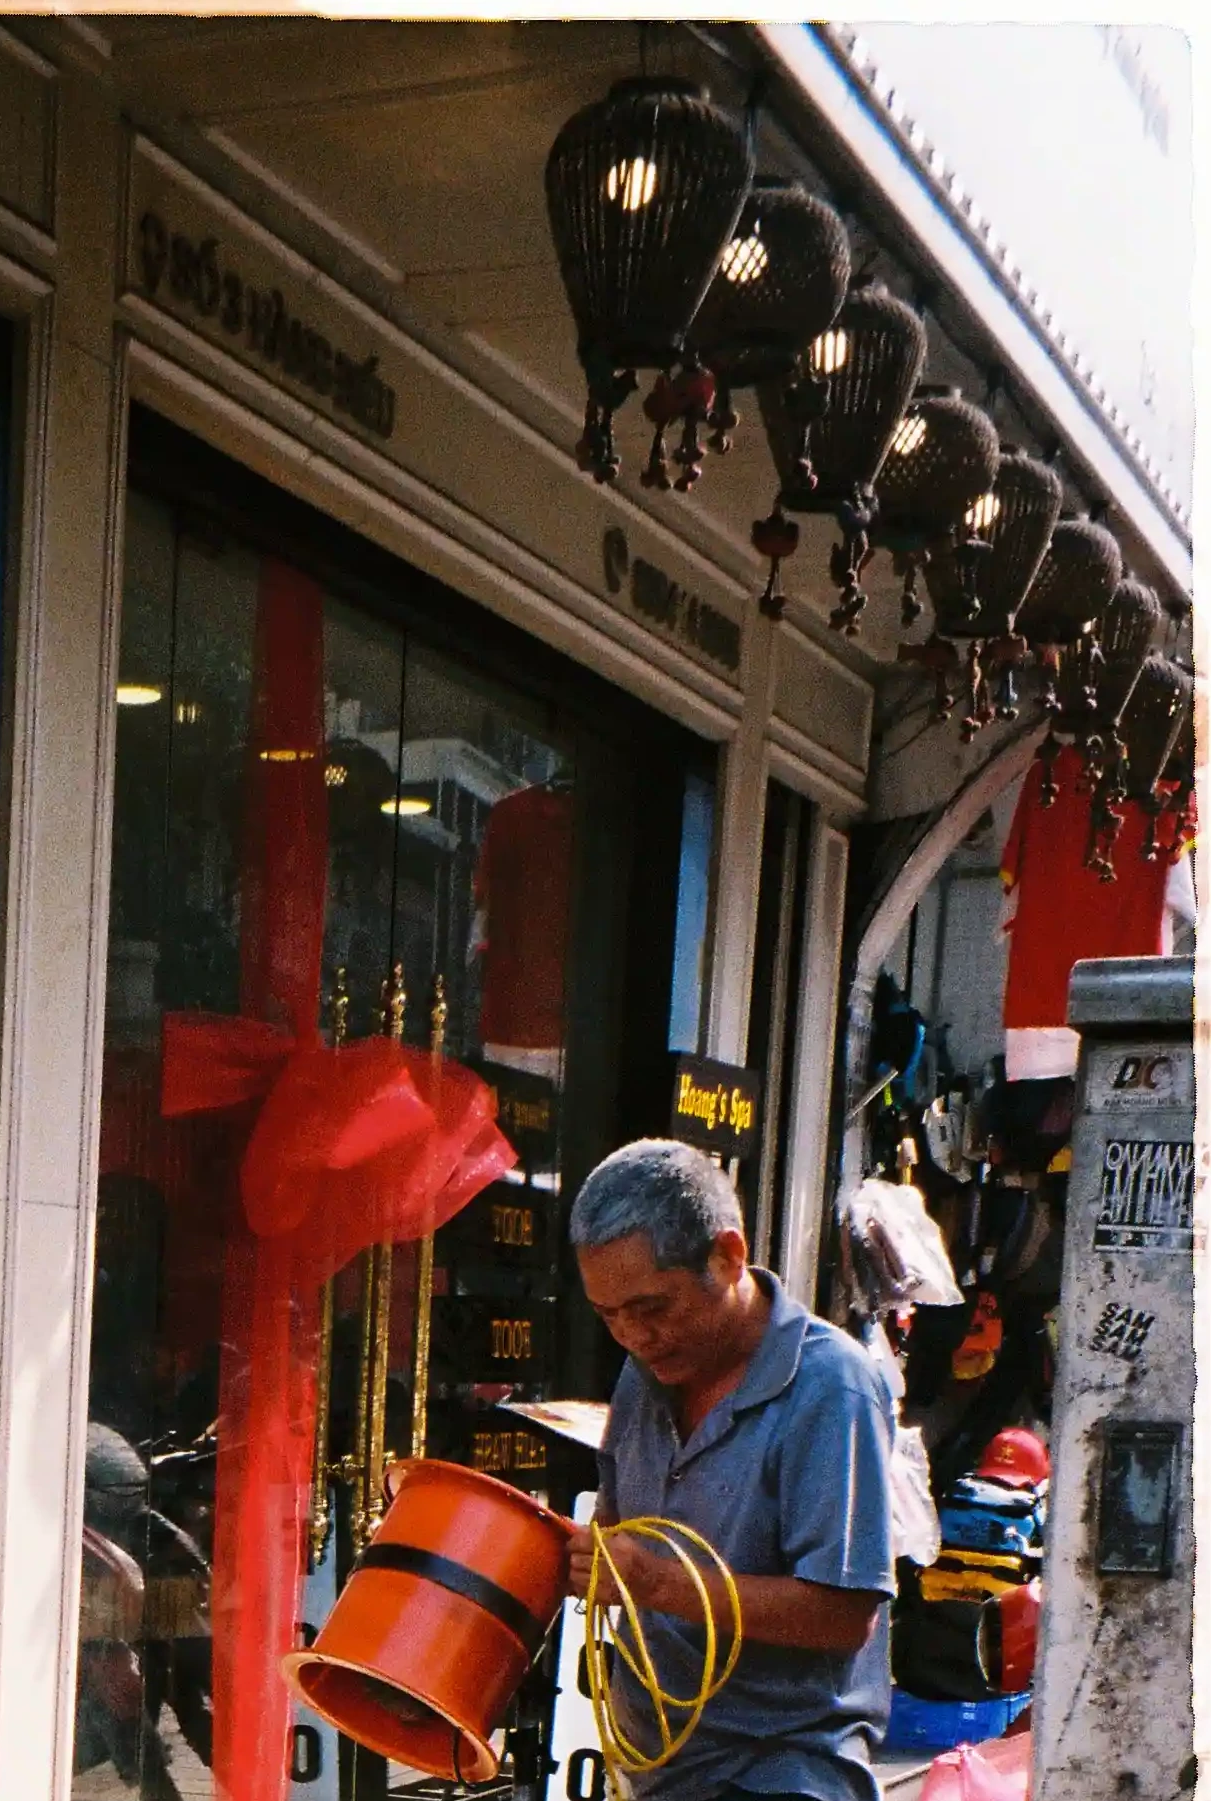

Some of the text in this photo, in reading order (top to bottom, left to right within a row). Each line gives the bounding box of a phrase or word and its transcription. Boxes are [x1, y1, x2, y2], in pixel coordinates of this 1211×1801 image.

[729, 1088, 752, 1136] Spa
[1100, 1302, 1156, 1331] SAM
[1094, 1318, 1150, 1347] SAM
